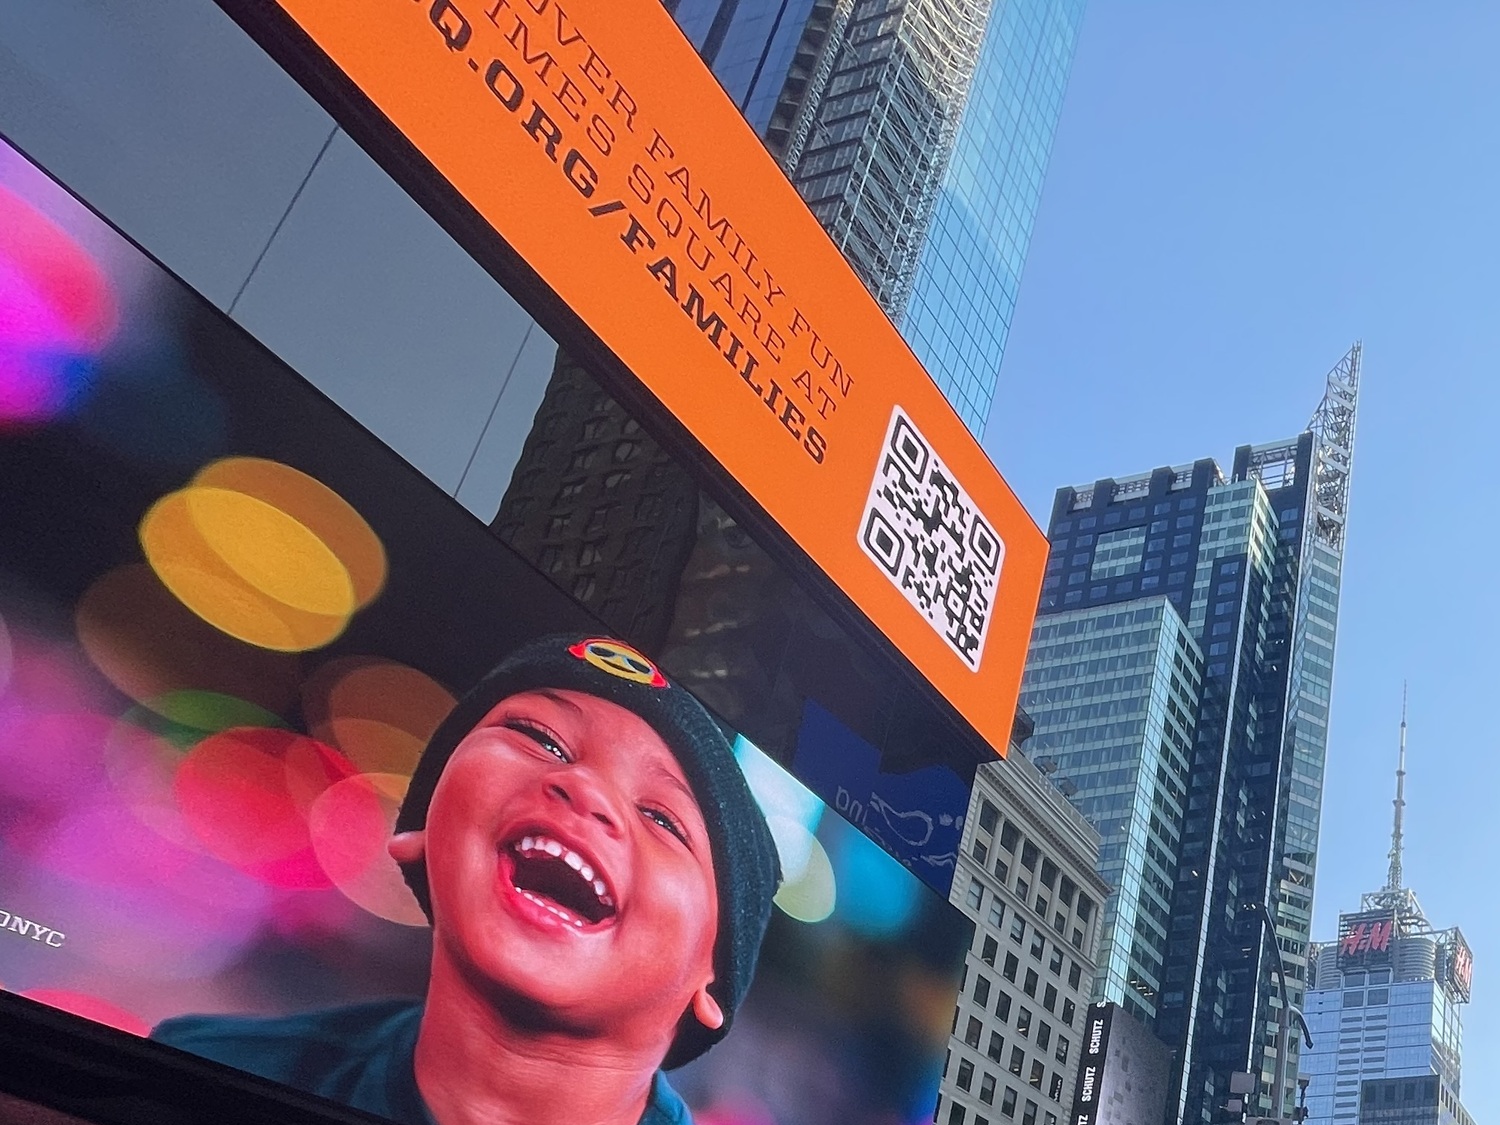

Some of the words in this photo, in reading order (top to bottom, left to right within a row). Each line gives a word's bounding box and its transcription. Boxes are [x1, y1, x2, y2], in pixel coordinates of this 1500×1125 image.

[414, 0, 827, 465] Q.ORG/FAMILIES
[627, 163, 786, 364] SQUARE
[791, 369, 837, 420] AT
[645, 127, 787, 307] FAMILY
[788, 307, 855, 398] FUN
[1081, 1066, 1096, 1103] SCHUTZ
[1089, 1018, 1104, 1055] SCHUTZ
